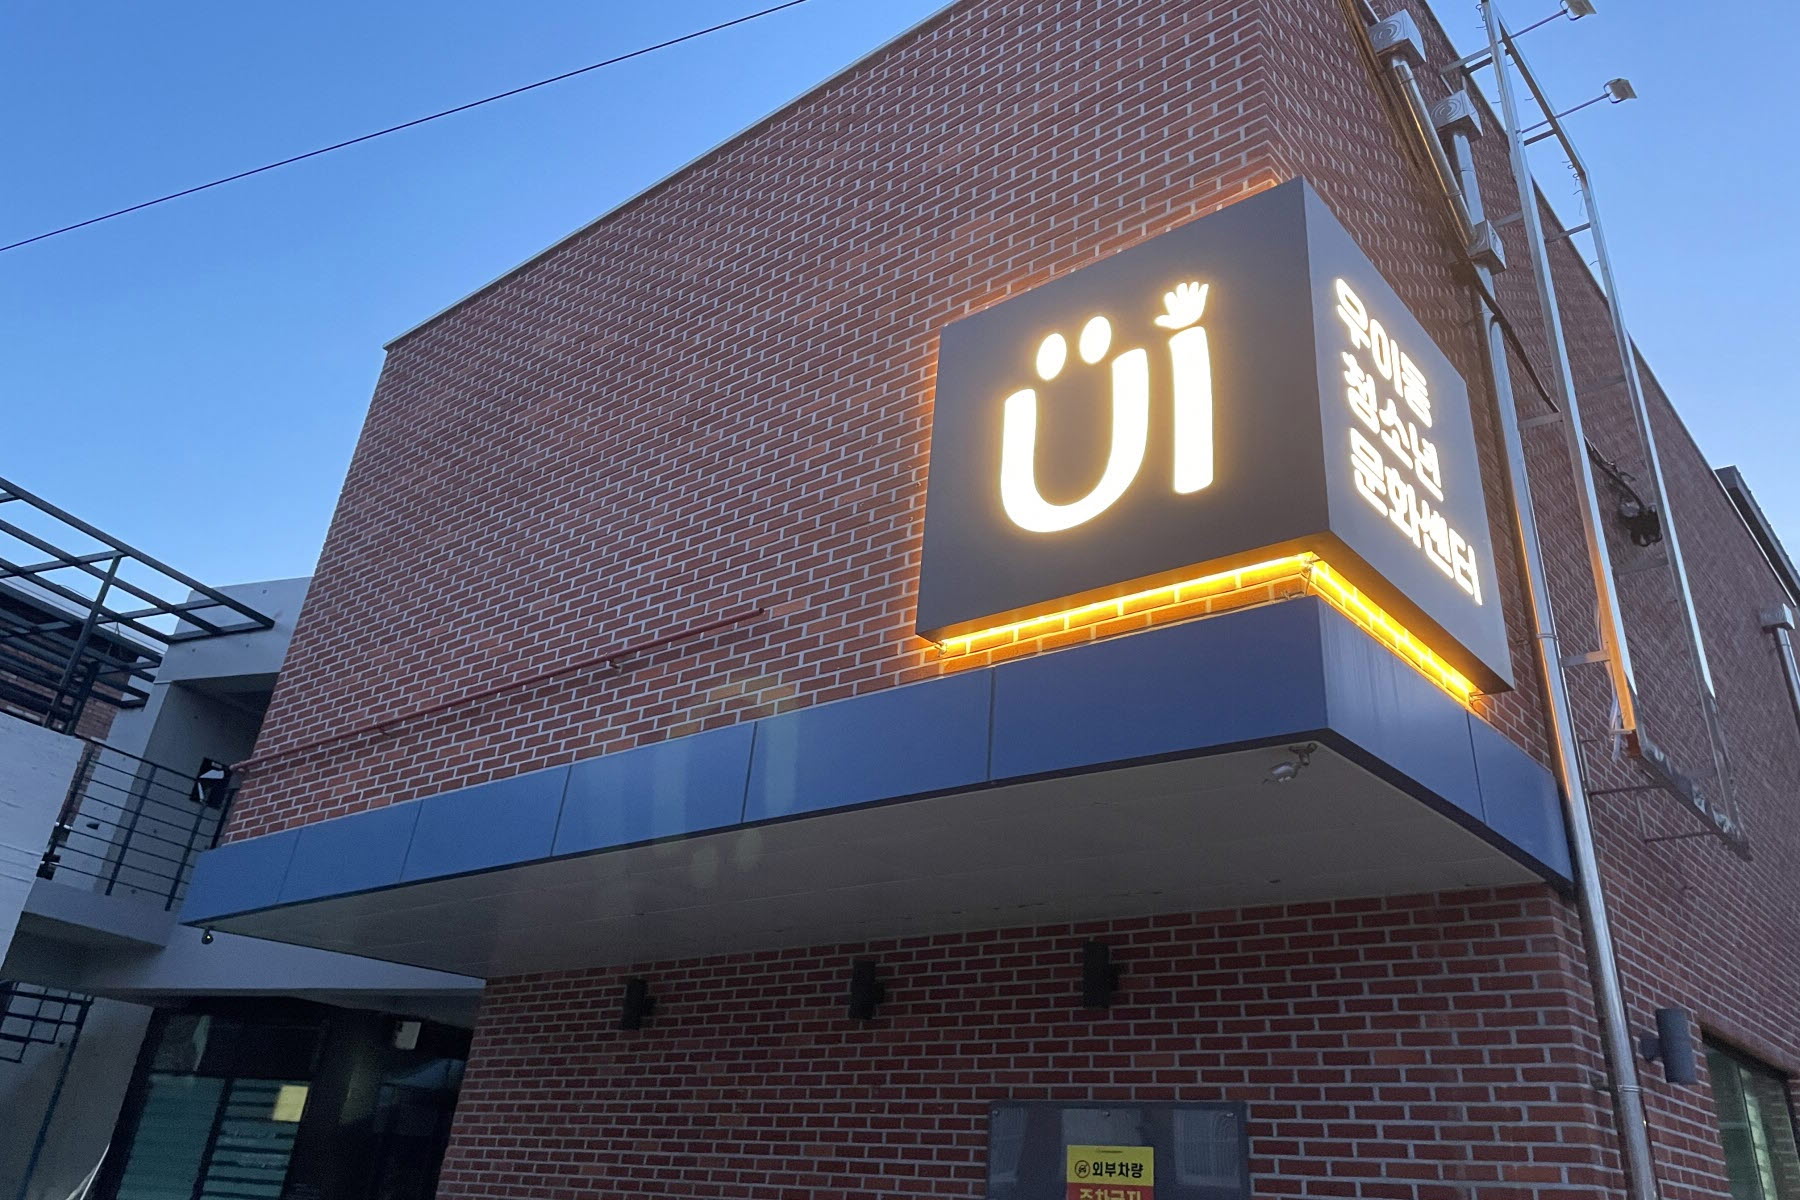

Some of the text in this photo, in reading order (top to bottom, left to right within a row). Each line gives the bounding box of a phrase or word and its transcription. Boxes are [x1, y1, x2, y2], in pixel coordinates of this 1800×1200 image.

[1335, 278, 1433, 429] 우이동
[1341, 351, 1444, 503] 청소년
[1349, 427, 1483, 606] 문화센터
[1092, 1161, 1144, 1178] 외부차량
